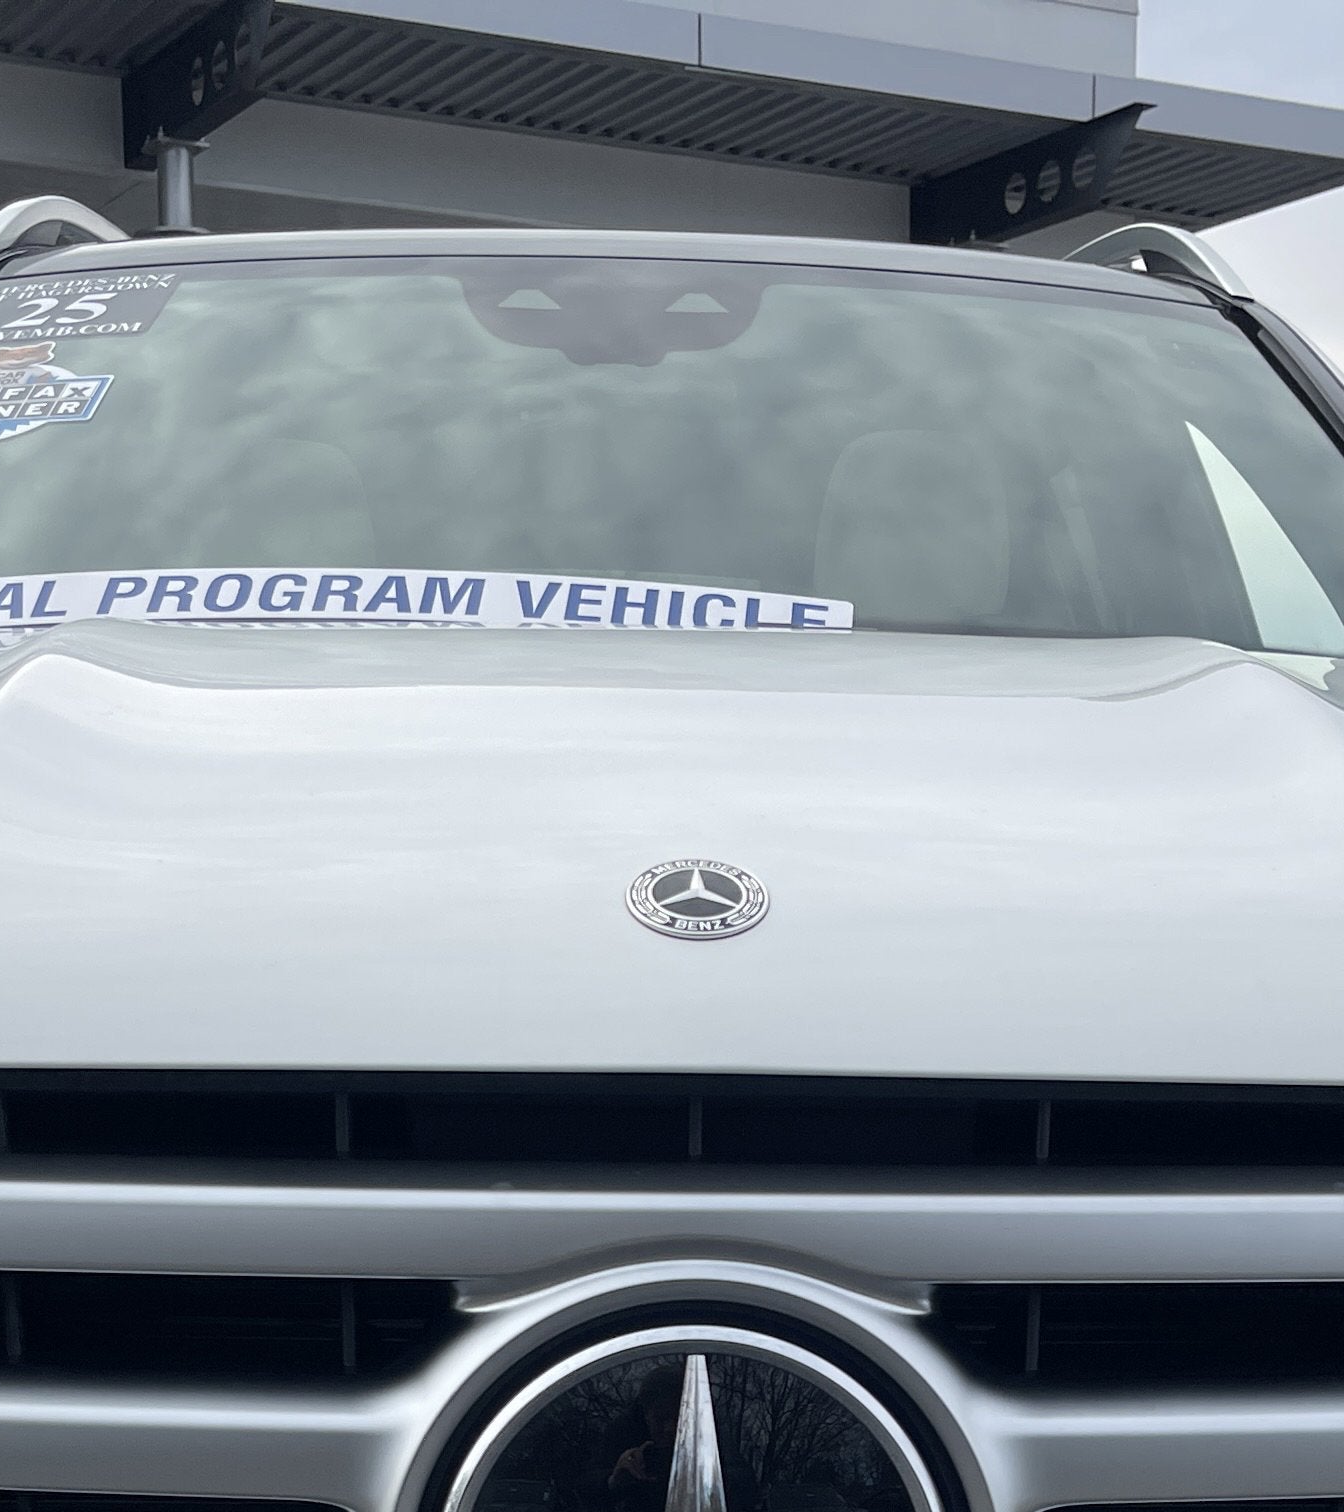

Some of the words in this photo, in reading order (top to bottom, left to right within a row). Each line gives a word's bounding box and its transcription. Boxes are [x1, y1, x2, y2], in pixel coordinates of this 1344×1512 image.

[18, 279, 175, 300] HAGERSTOWN
[1, 293, 118, 328] 25
[97, 573, 486, 616] PROGRAM
[516, 580, 830, 629] VEHICLE
[651, 860, 742, 876] MERCEDES
[674, 919, 726, 931] BENZ
